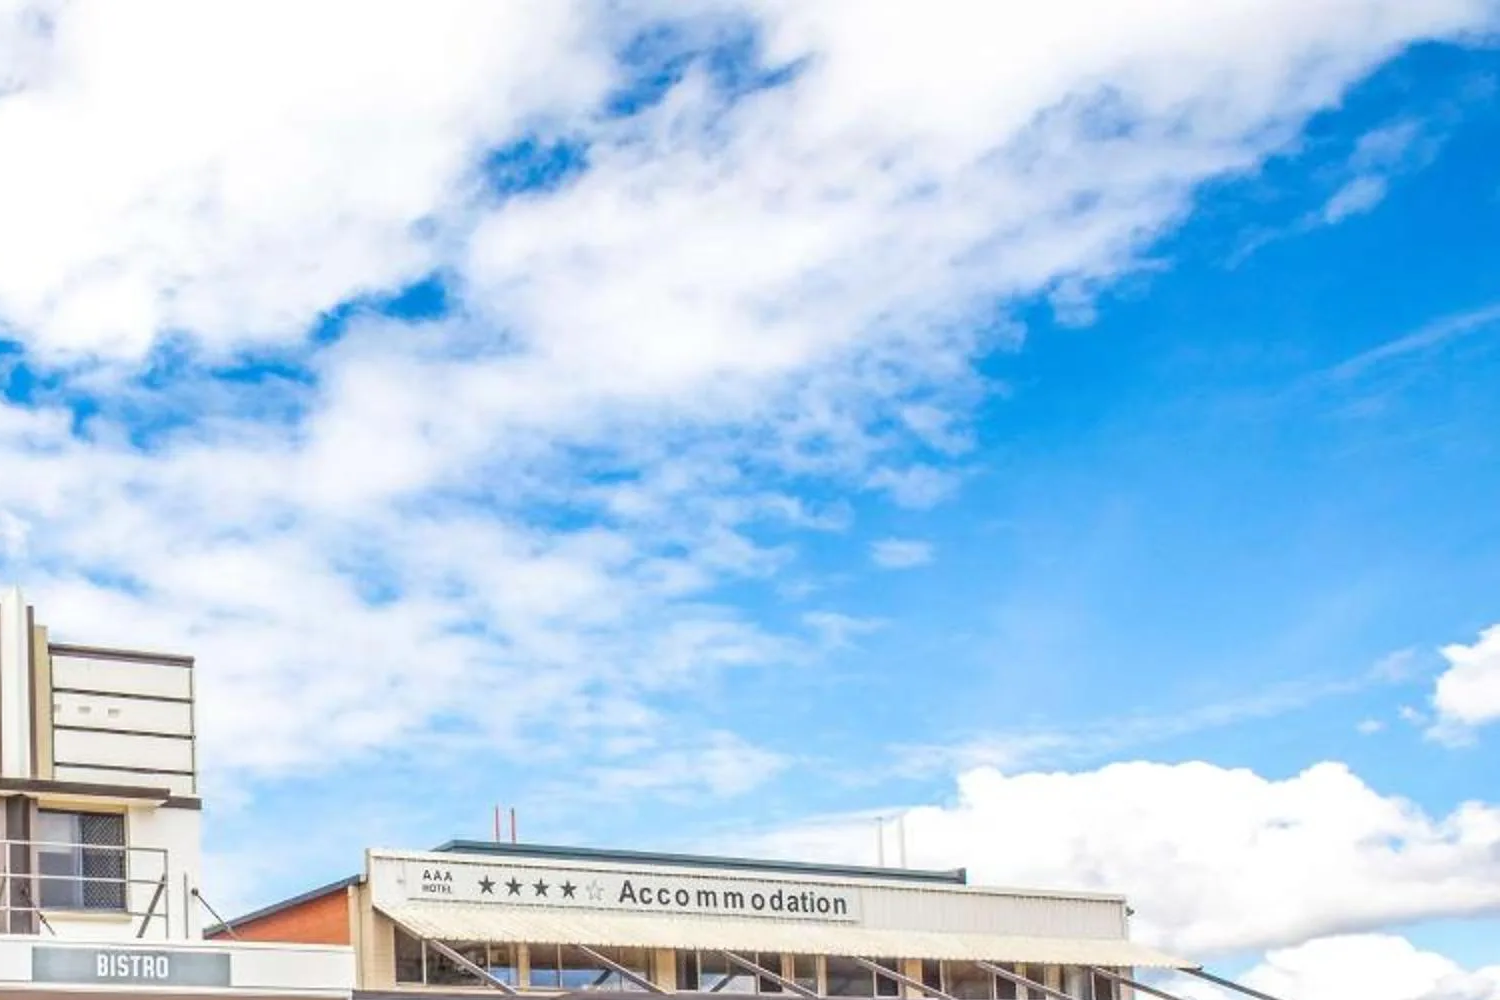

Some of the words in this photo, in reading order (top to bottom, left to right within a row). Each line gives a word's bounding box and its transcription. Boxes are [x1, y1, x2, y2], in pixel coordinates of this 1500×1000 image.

[422, 869, 453, 881] AAA
[618, 879, 848, 915] Accommodation
[96, 953, 169, 979] BISTRO
